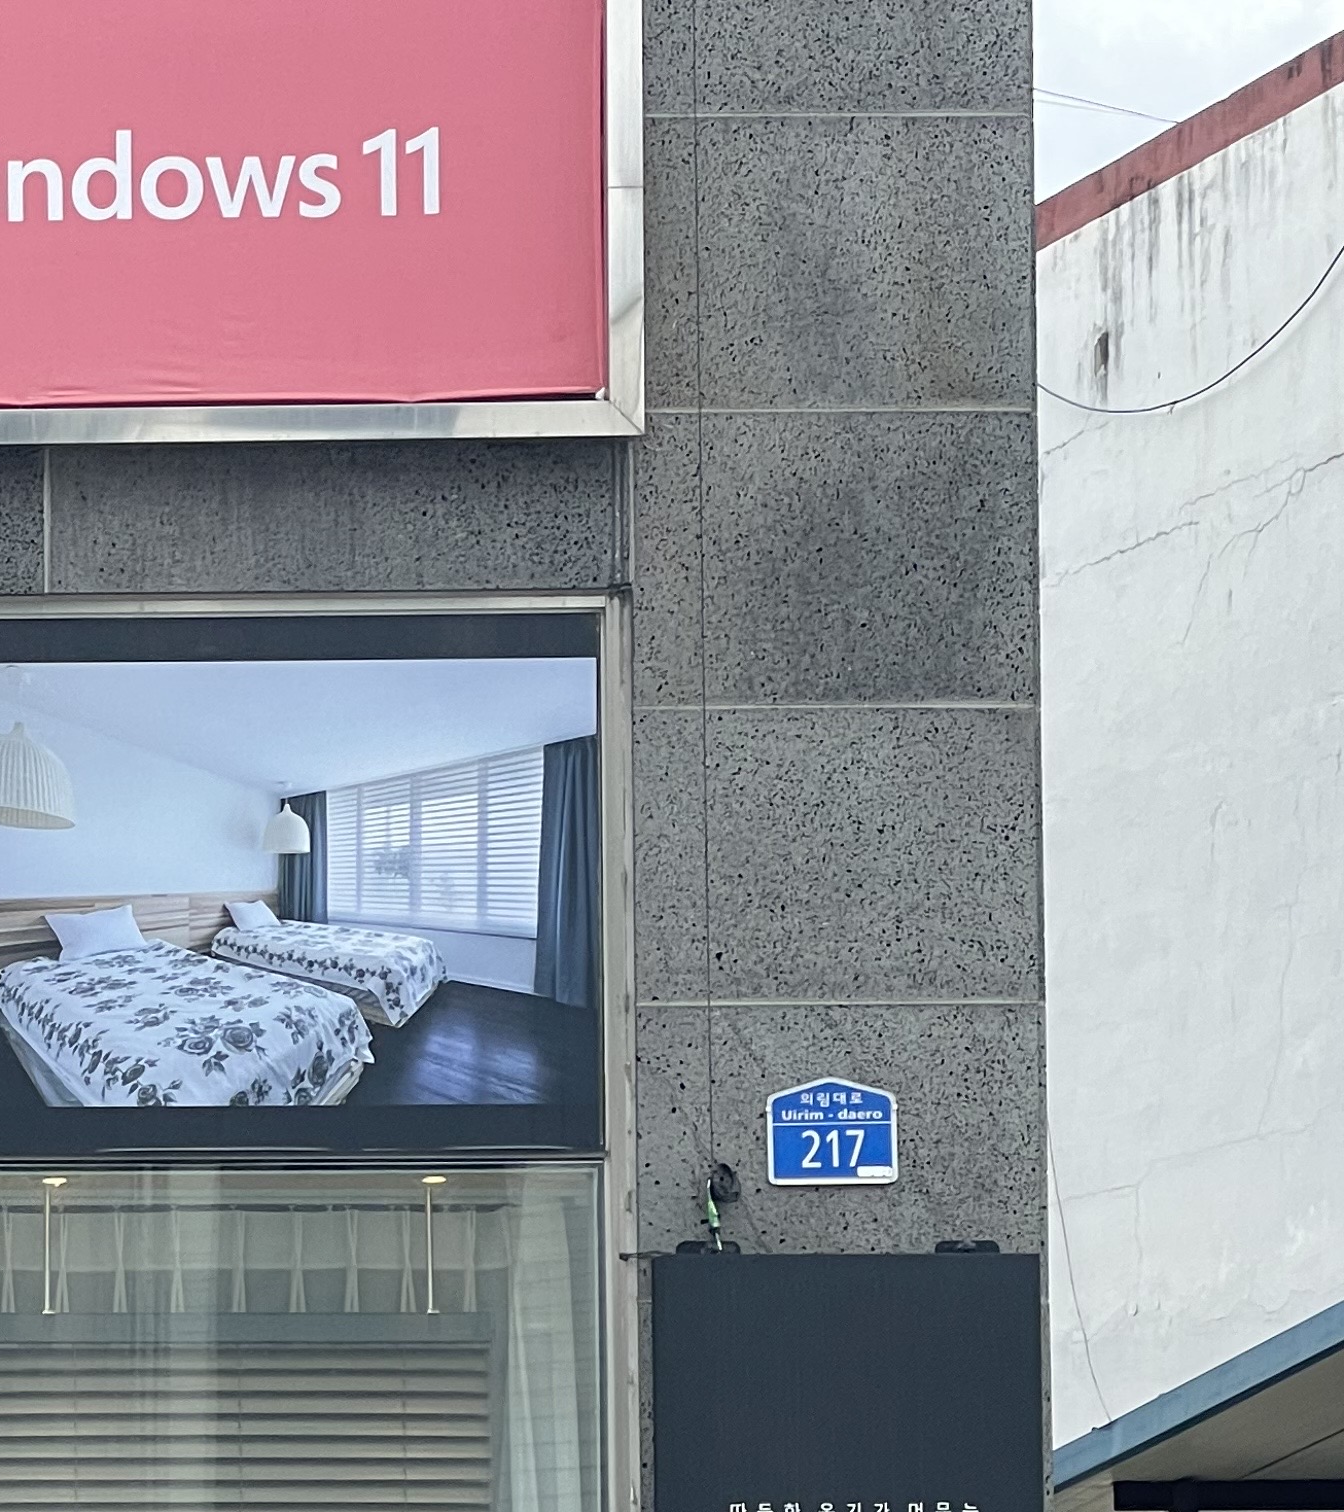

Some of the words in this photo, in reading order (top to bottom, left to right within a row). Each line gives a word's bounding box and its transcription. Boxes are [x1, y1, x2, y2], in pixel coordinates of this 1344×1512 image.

[362, 126, 440, 216] 11
[800, 1091, 863, 1108] 의림대로
[801, 1129, 865, 1169] 217
